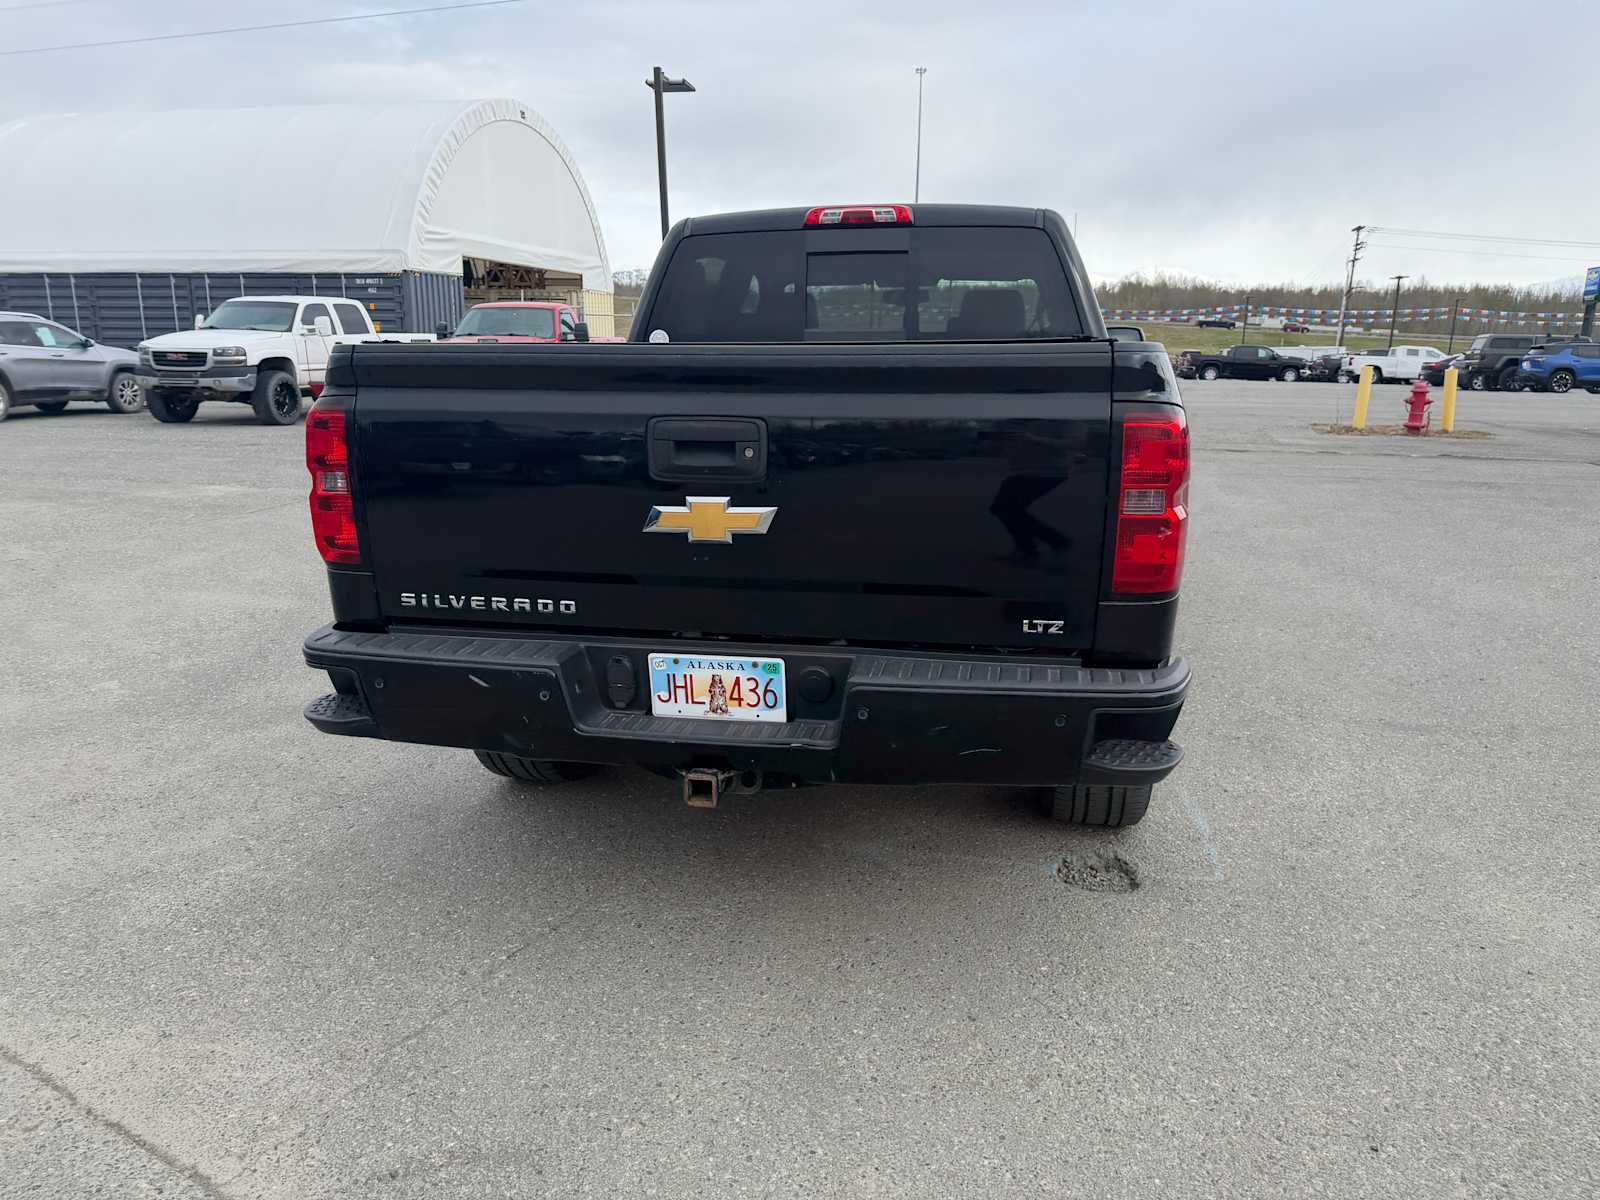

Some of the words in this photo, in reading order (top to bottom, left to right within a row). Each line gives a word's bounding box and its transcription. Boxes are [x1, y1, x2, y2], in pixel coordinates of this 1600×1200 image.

[400, 592, 577, 614] SILVERADO
[1022, 619, 1065, 634] LTZ
[686, 660, 746, 671] ALASKA
[767, 663, 777, 673] 25
[656, 673, 706, 705] JHL
[728, 675, 778, 709] 436
